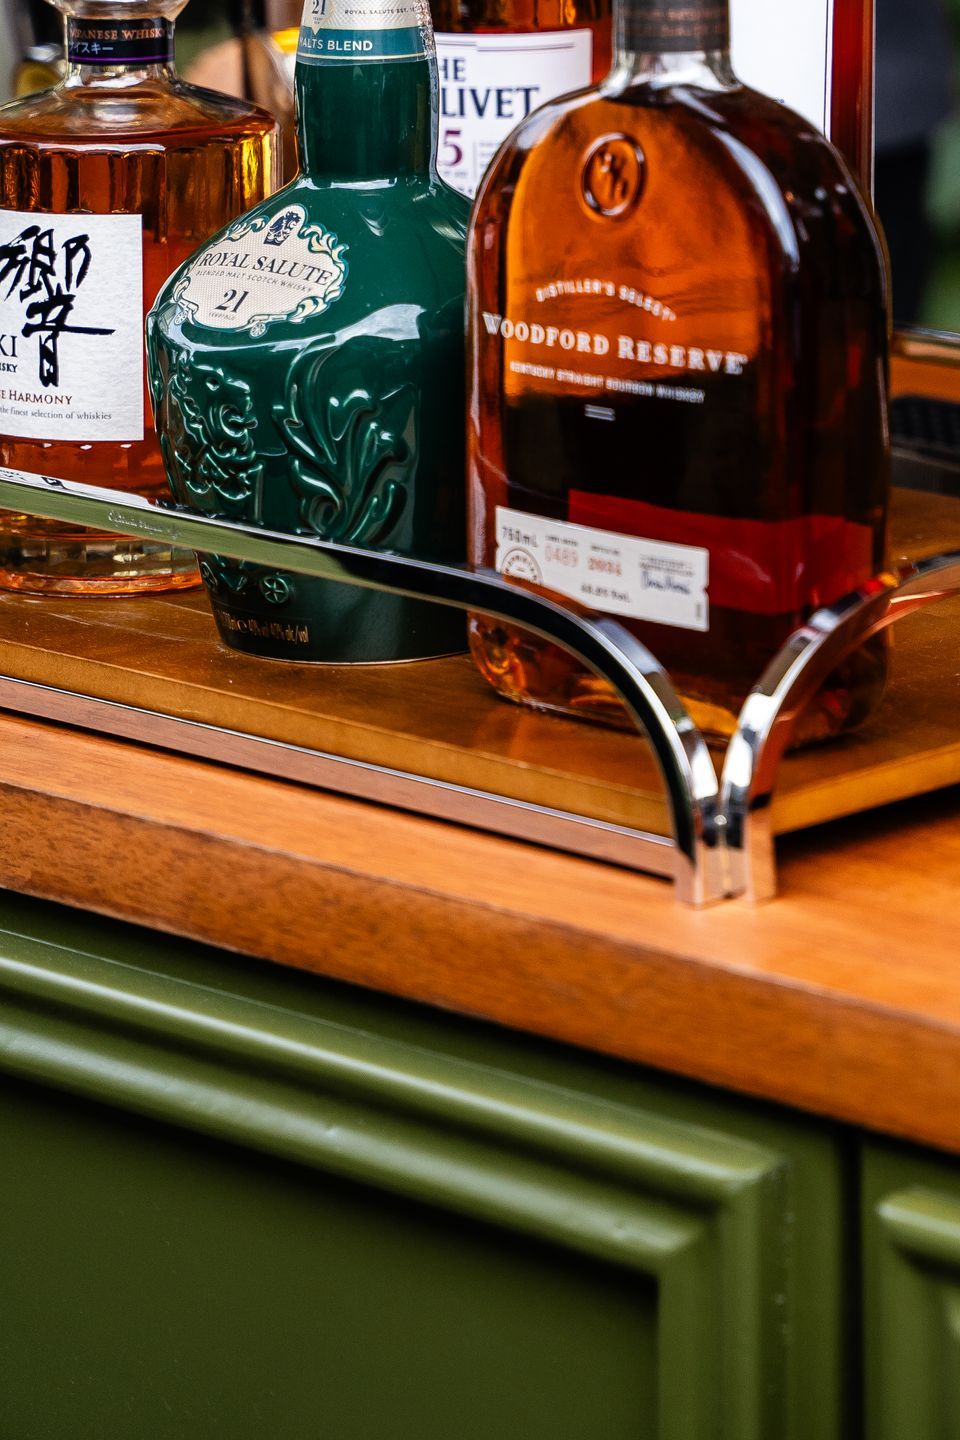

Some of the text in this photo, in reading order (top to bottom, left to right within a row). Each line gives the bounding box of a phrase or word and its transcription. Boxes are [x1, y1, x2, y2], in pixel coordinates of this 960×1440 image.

[327, 40, 373, 51] BLEND
[199, 252, 333, 286] ROYAL SALUTE
[247, 274, 277, 284] SCOTCH
[214, 288, 250, 313] 21
[482, 311, 748, 375] WOODFORD RESERVE
[9, 389, 73, 405] HARMONY
[10, 406, 28, 417] finest
[31, 409, 63, 419] selection
[65, 411, 74, 420] of
[76, 411, 112, 420] whiskies
